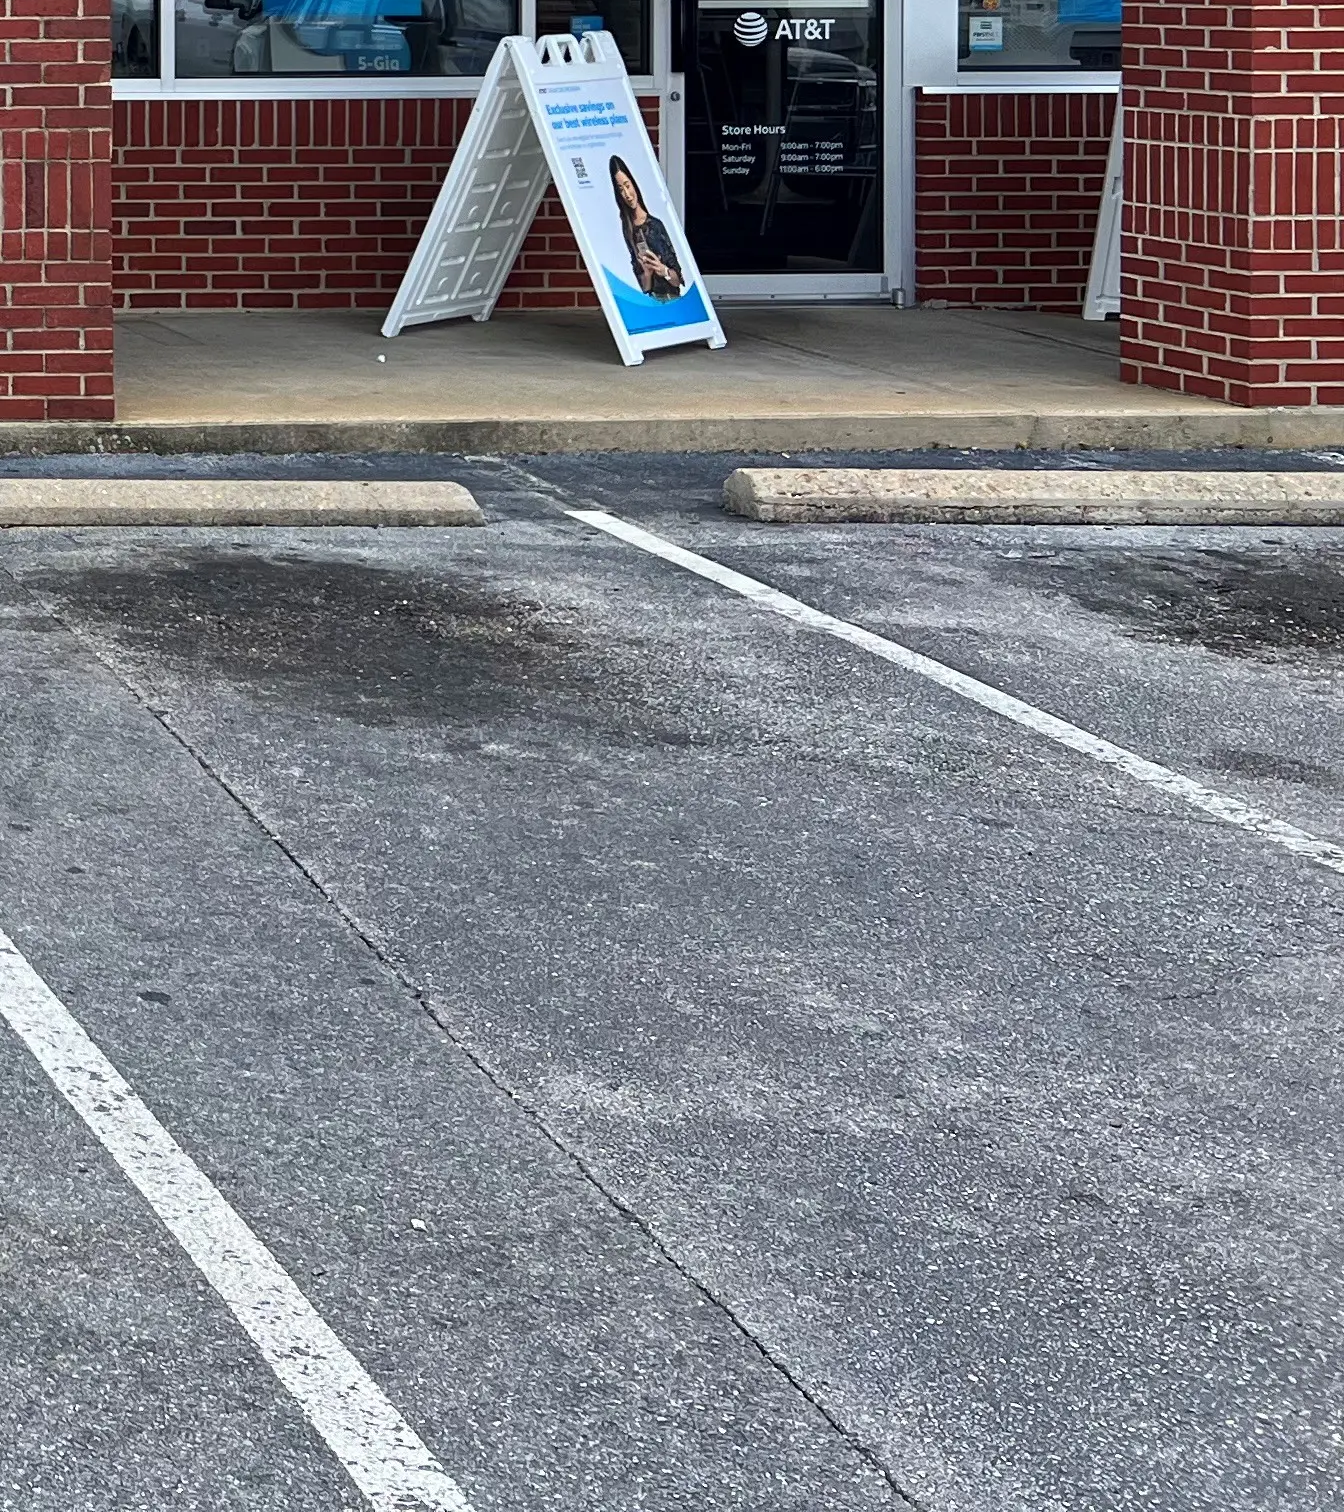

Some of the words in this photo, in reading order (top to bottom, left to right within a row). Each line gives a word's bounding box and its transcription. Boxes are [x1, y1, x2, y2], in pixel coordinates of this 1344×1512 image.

[774, 18, 836, 41] AT&T
[721, 124, 752, 136] Store
[754, 124, 786, 135] Hours
[721, 142, 752, 151] Mon-Fri
[815, 141, 844, 151] 7:00pm
[722, 154, 756, 164] Saturday
[815, 153, 844, 162] 7:00pm
[722, 166, 750, 175] Sunday
